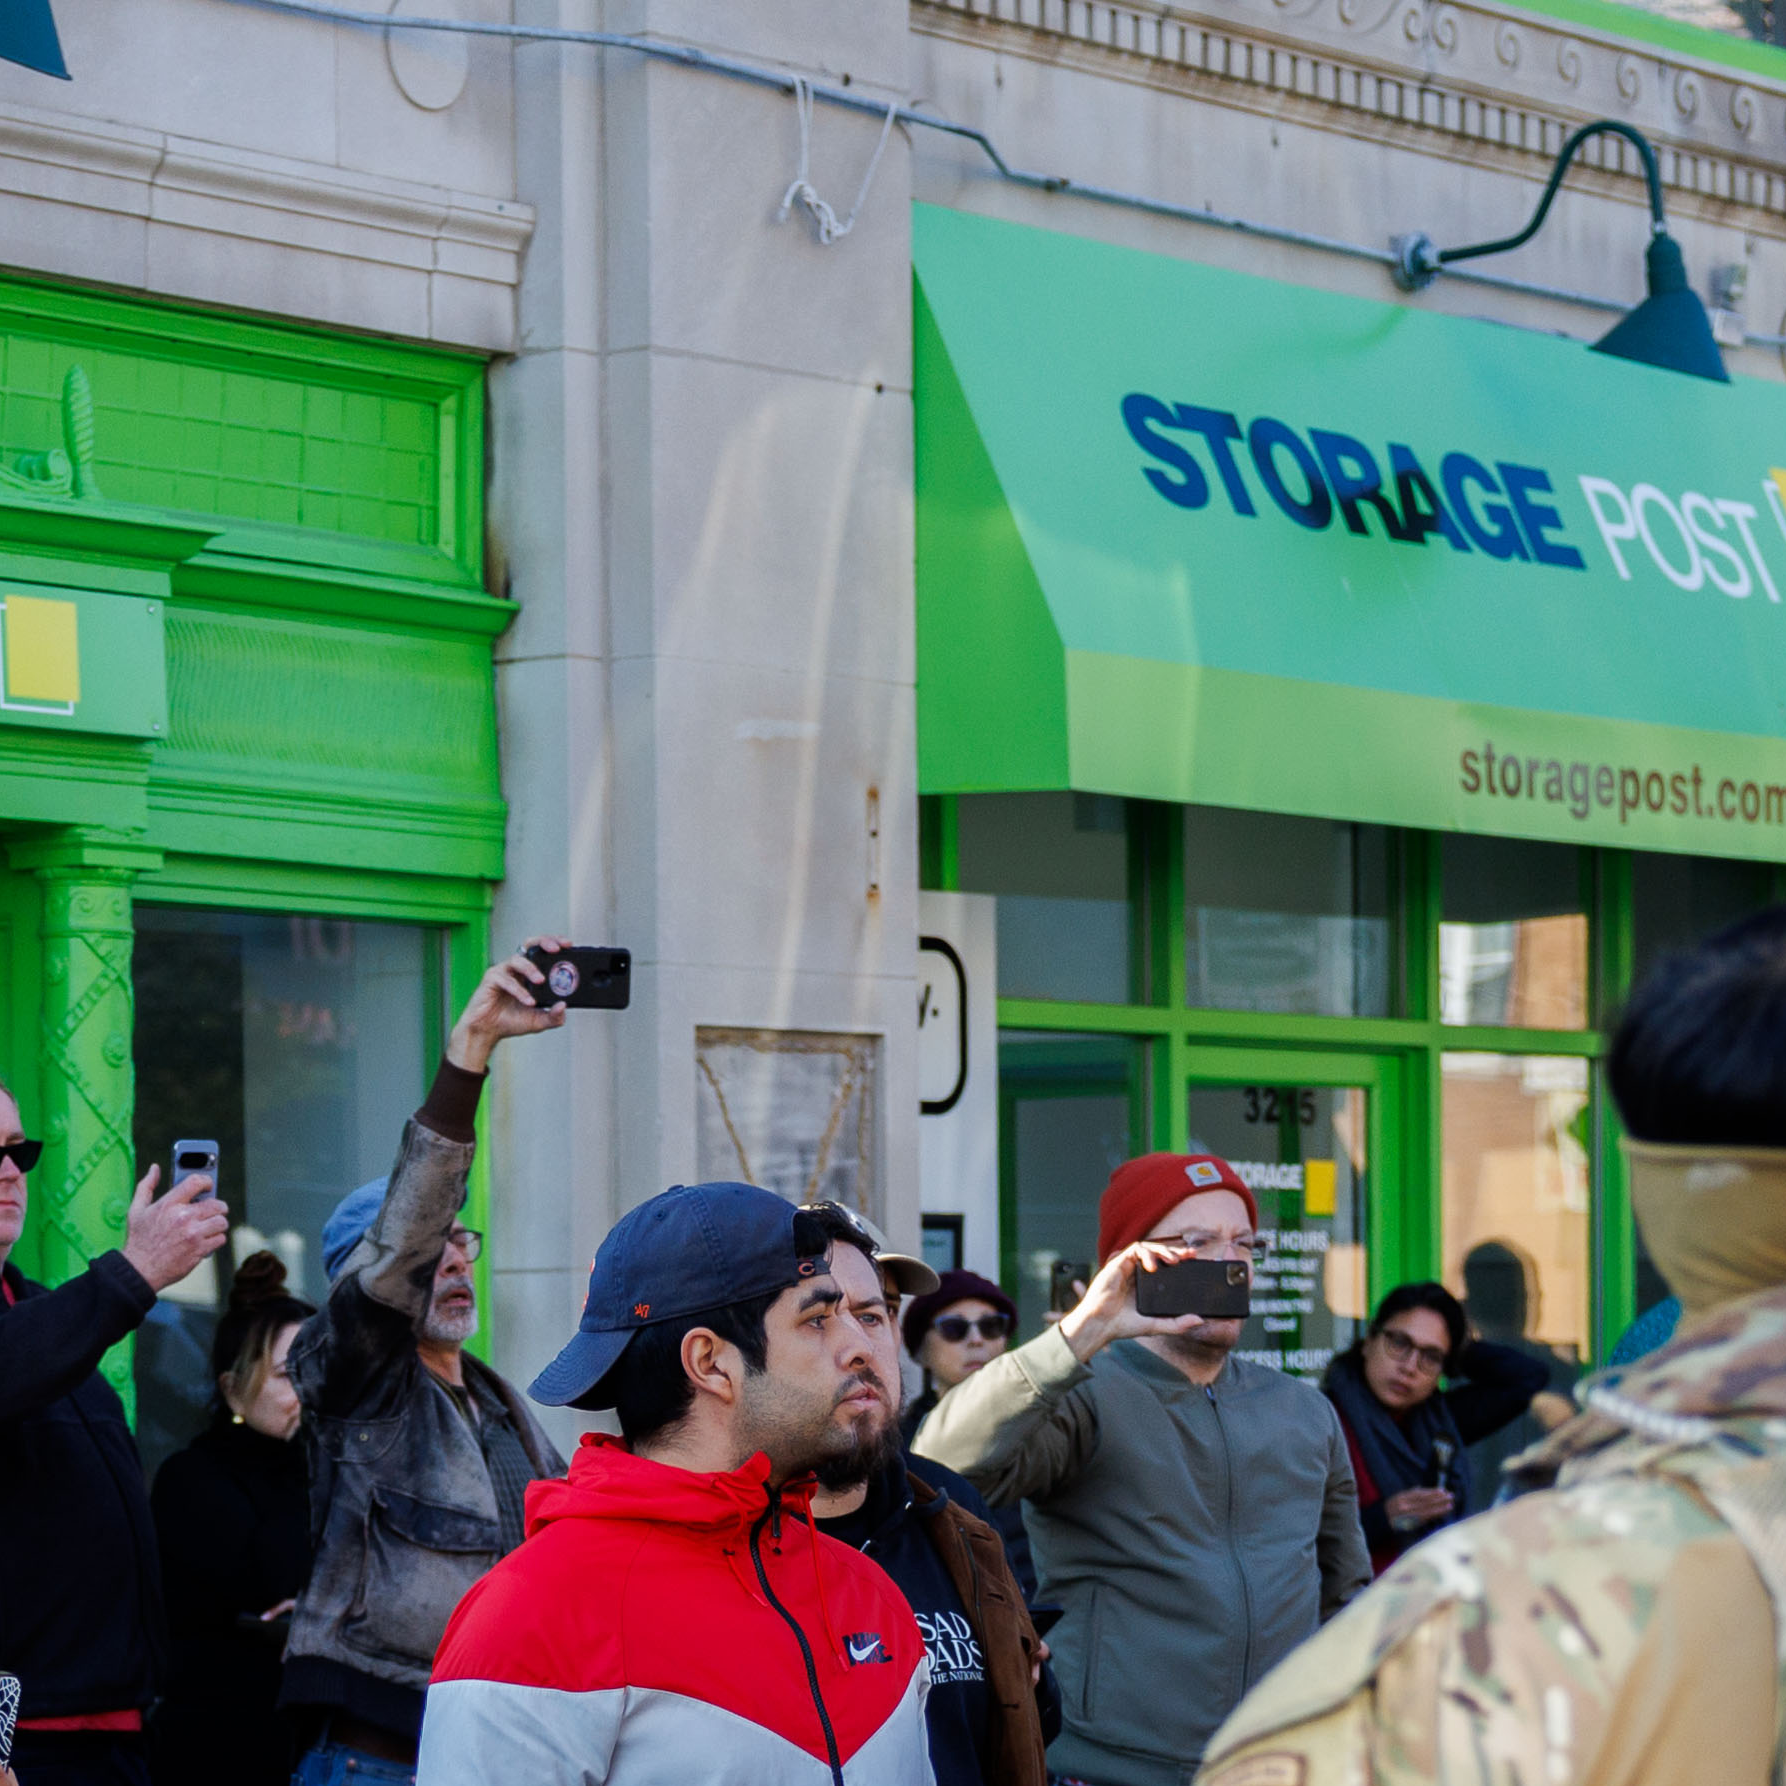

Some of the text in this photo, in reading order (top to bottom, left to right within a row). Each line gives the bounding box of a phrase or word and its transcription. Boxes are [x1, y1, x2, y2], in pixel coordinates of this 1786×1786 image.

[1120, 393, 1782, 602] STORAGE POST
[1228, 1160, 1303, 1190] TORAGE
[914, 1611, 971, 1642] SAD
